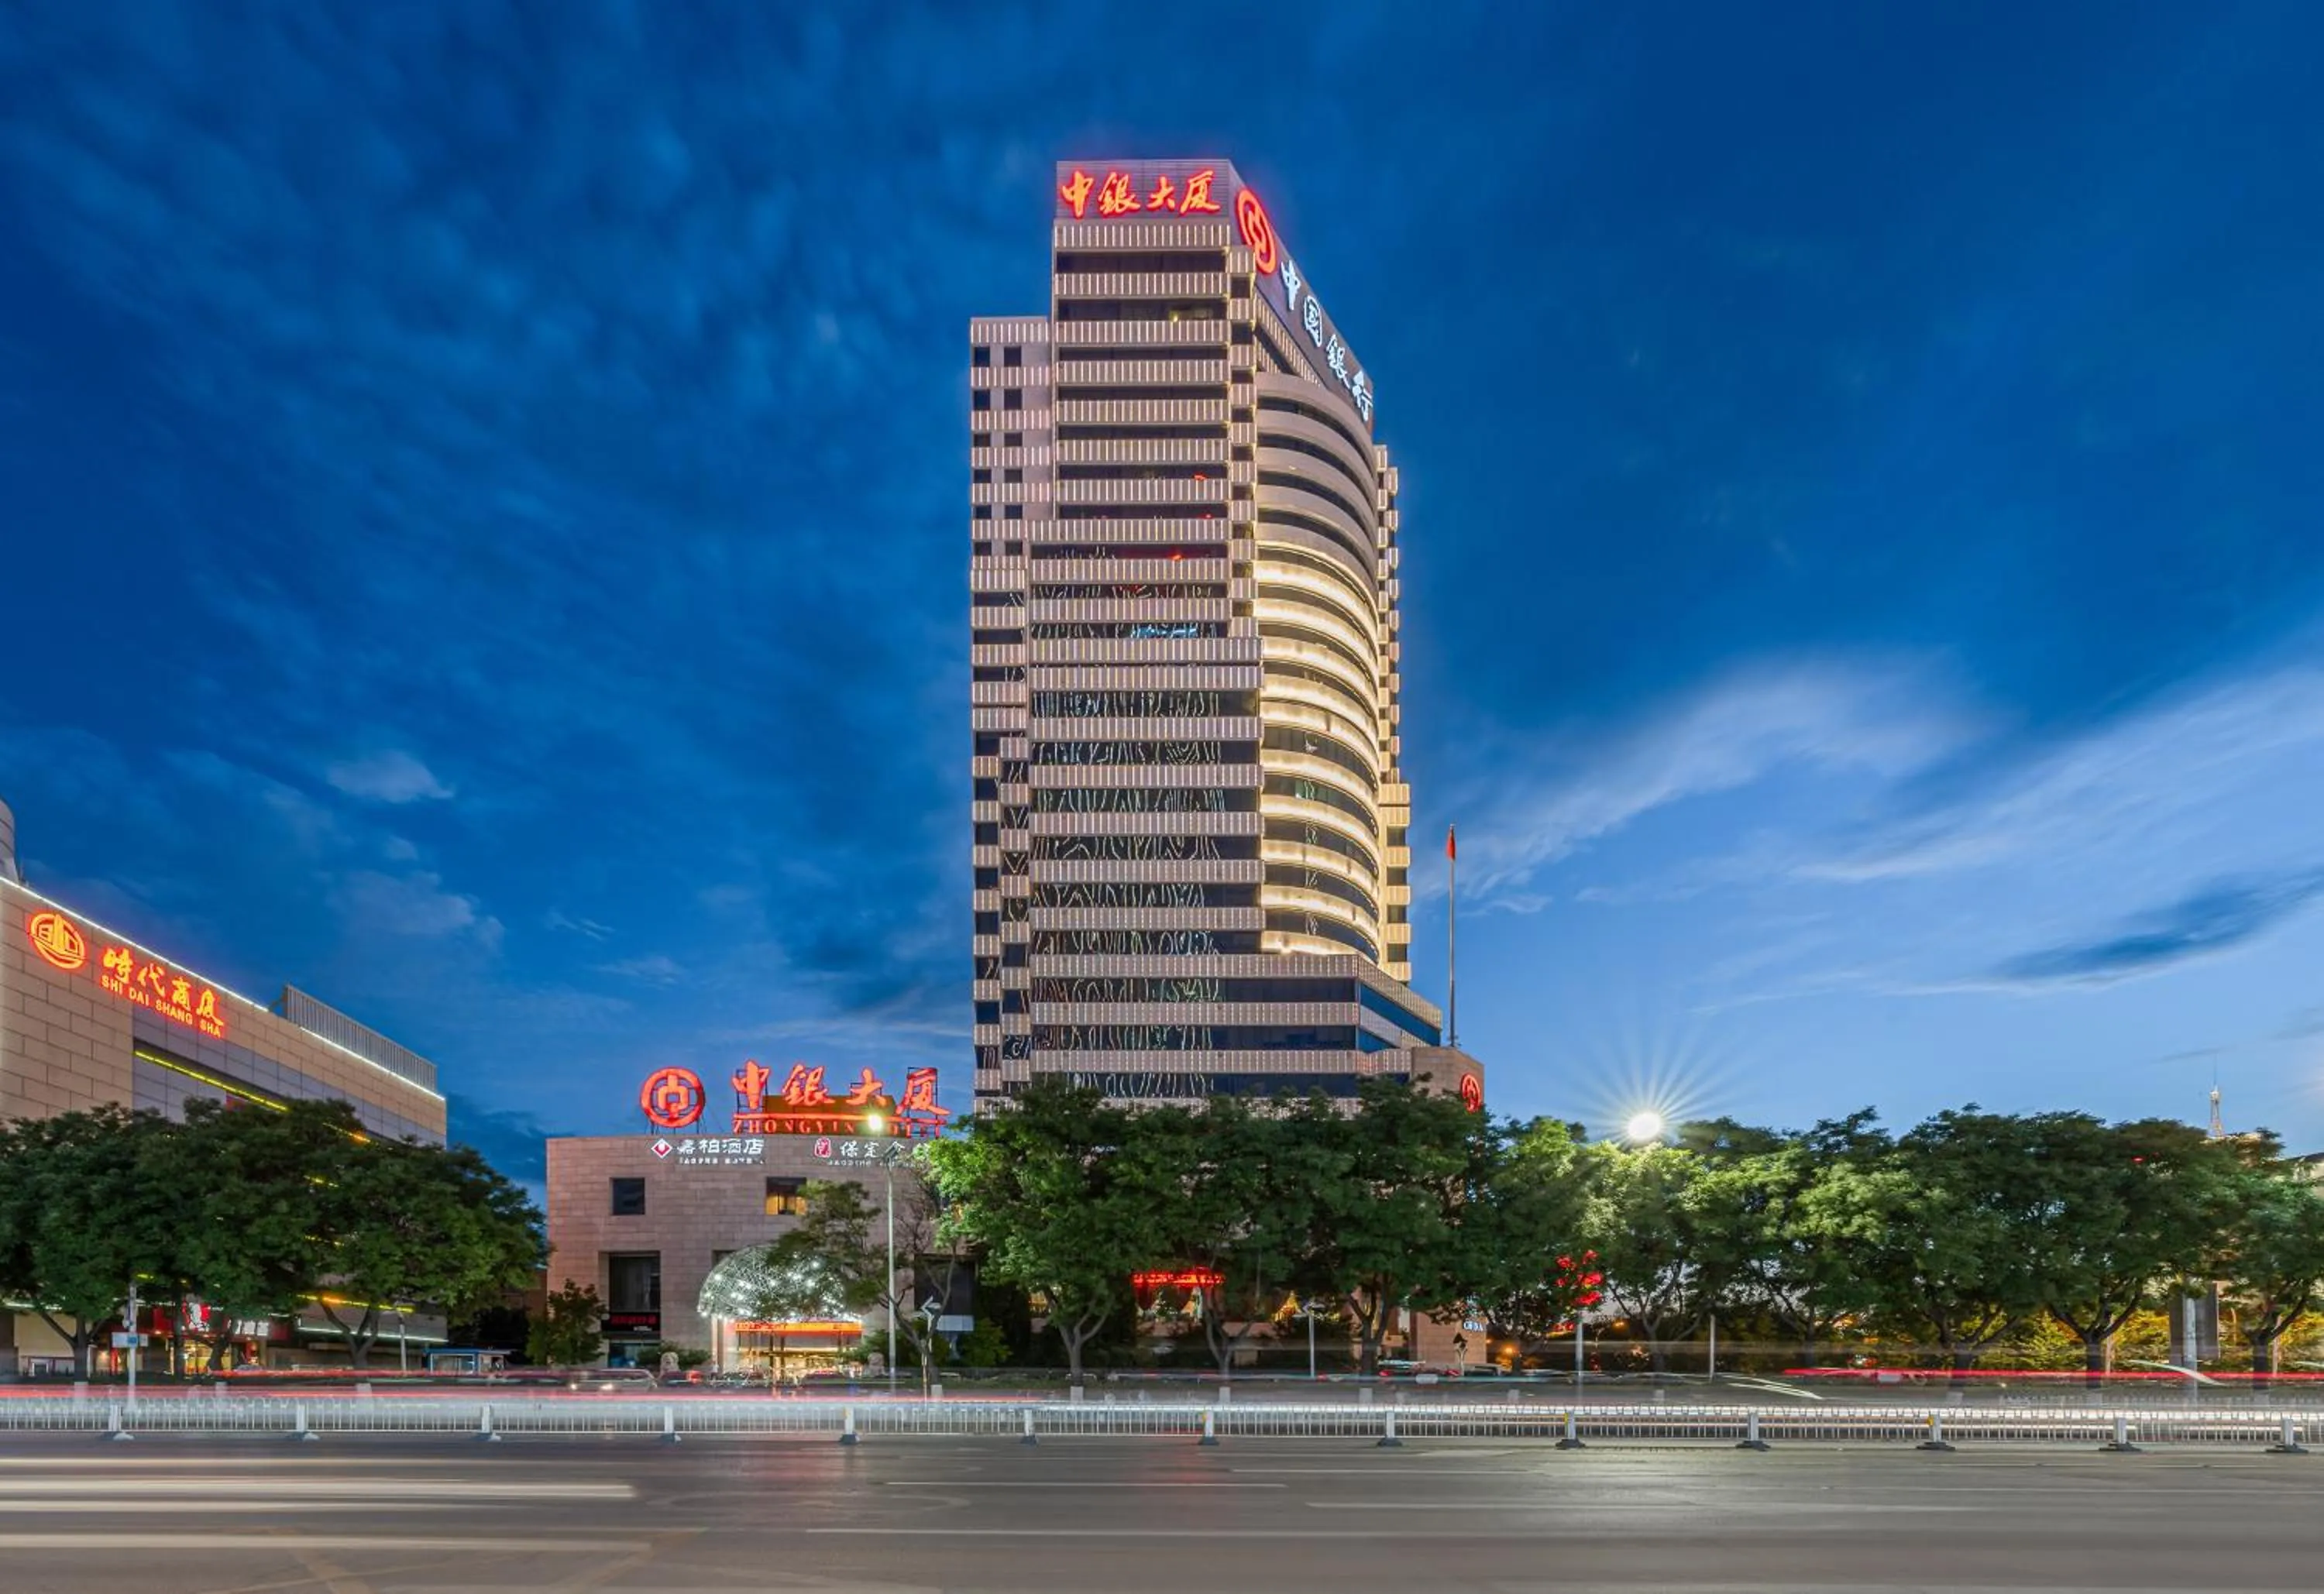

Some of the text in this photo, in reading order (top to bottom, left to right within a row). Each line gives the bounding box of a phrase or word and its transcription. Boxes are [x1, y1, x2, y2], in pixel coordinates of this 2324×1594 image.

[101, 974, 221, 1039] SHI DAI SHANG SHA
[732, 1119, 855, 1135] ZHONGYIN
[839, 1139, 931, 1159] 保定
